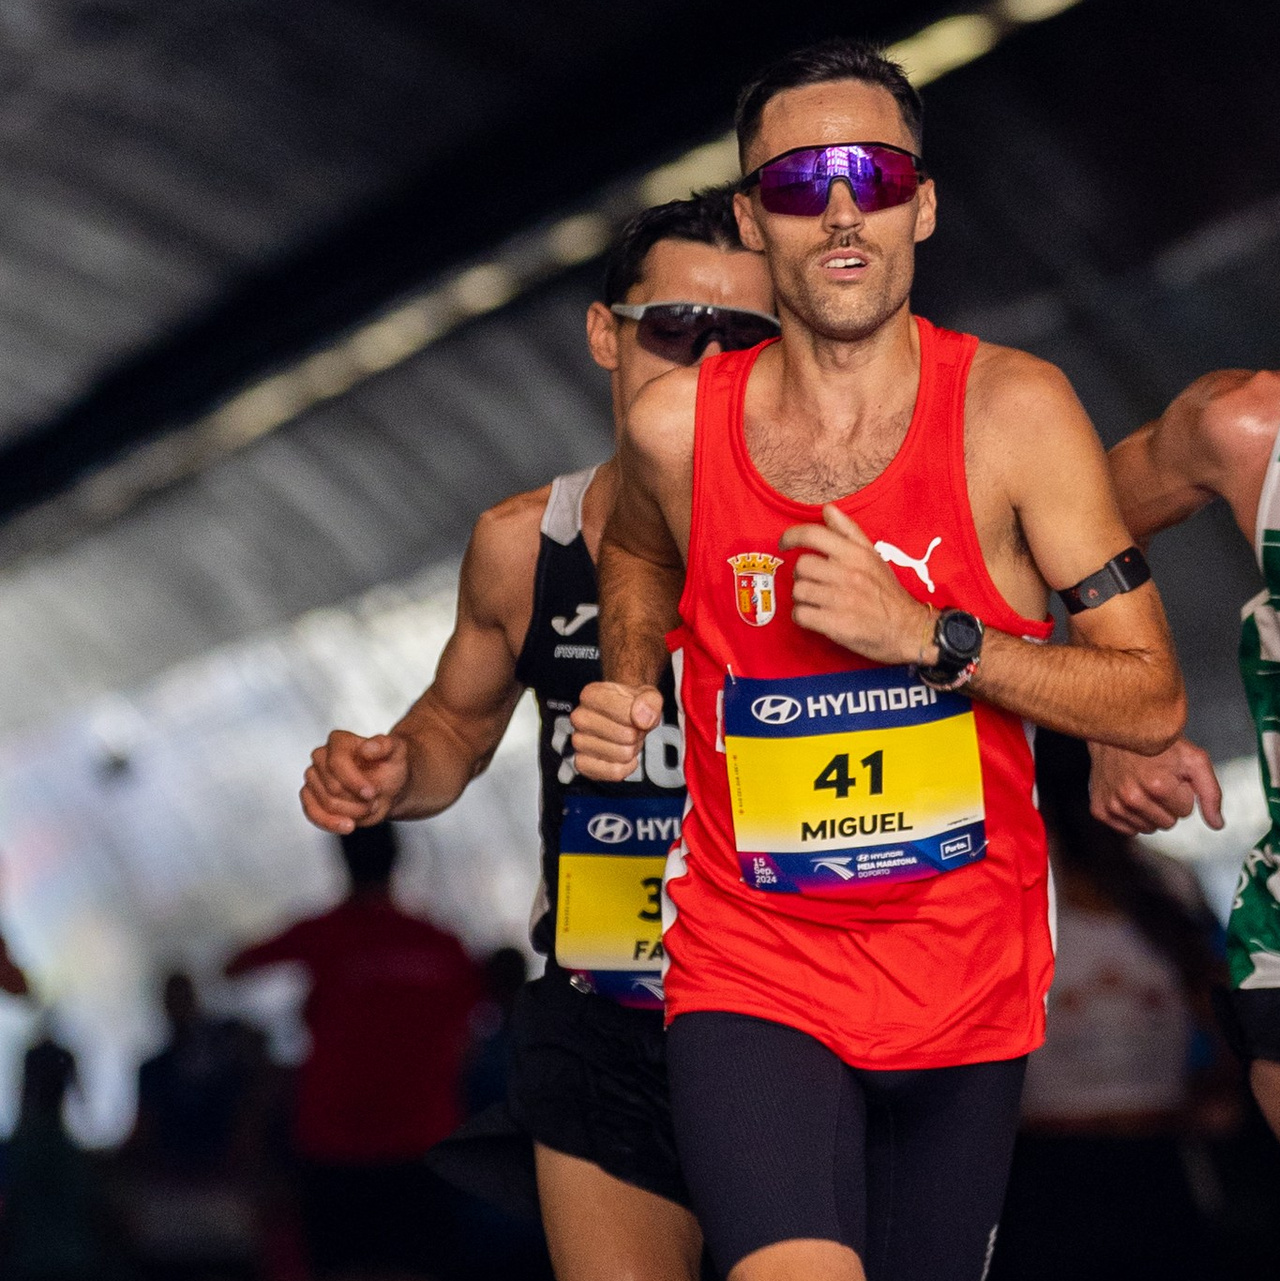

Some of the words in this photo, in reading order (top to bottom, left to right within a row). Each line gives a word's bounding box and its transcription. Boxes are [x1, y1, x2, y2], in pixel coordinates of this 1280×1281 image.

[806, 685, 938, 719] HYUNDAI
[813, 749, 884, 799] 41
[801, 811, 914, 842] MIGUEL
[753, 857, 766, 868] 15
[876, 856, 918, 869] MARATONA
[755, 875, 777, 884] 2024
